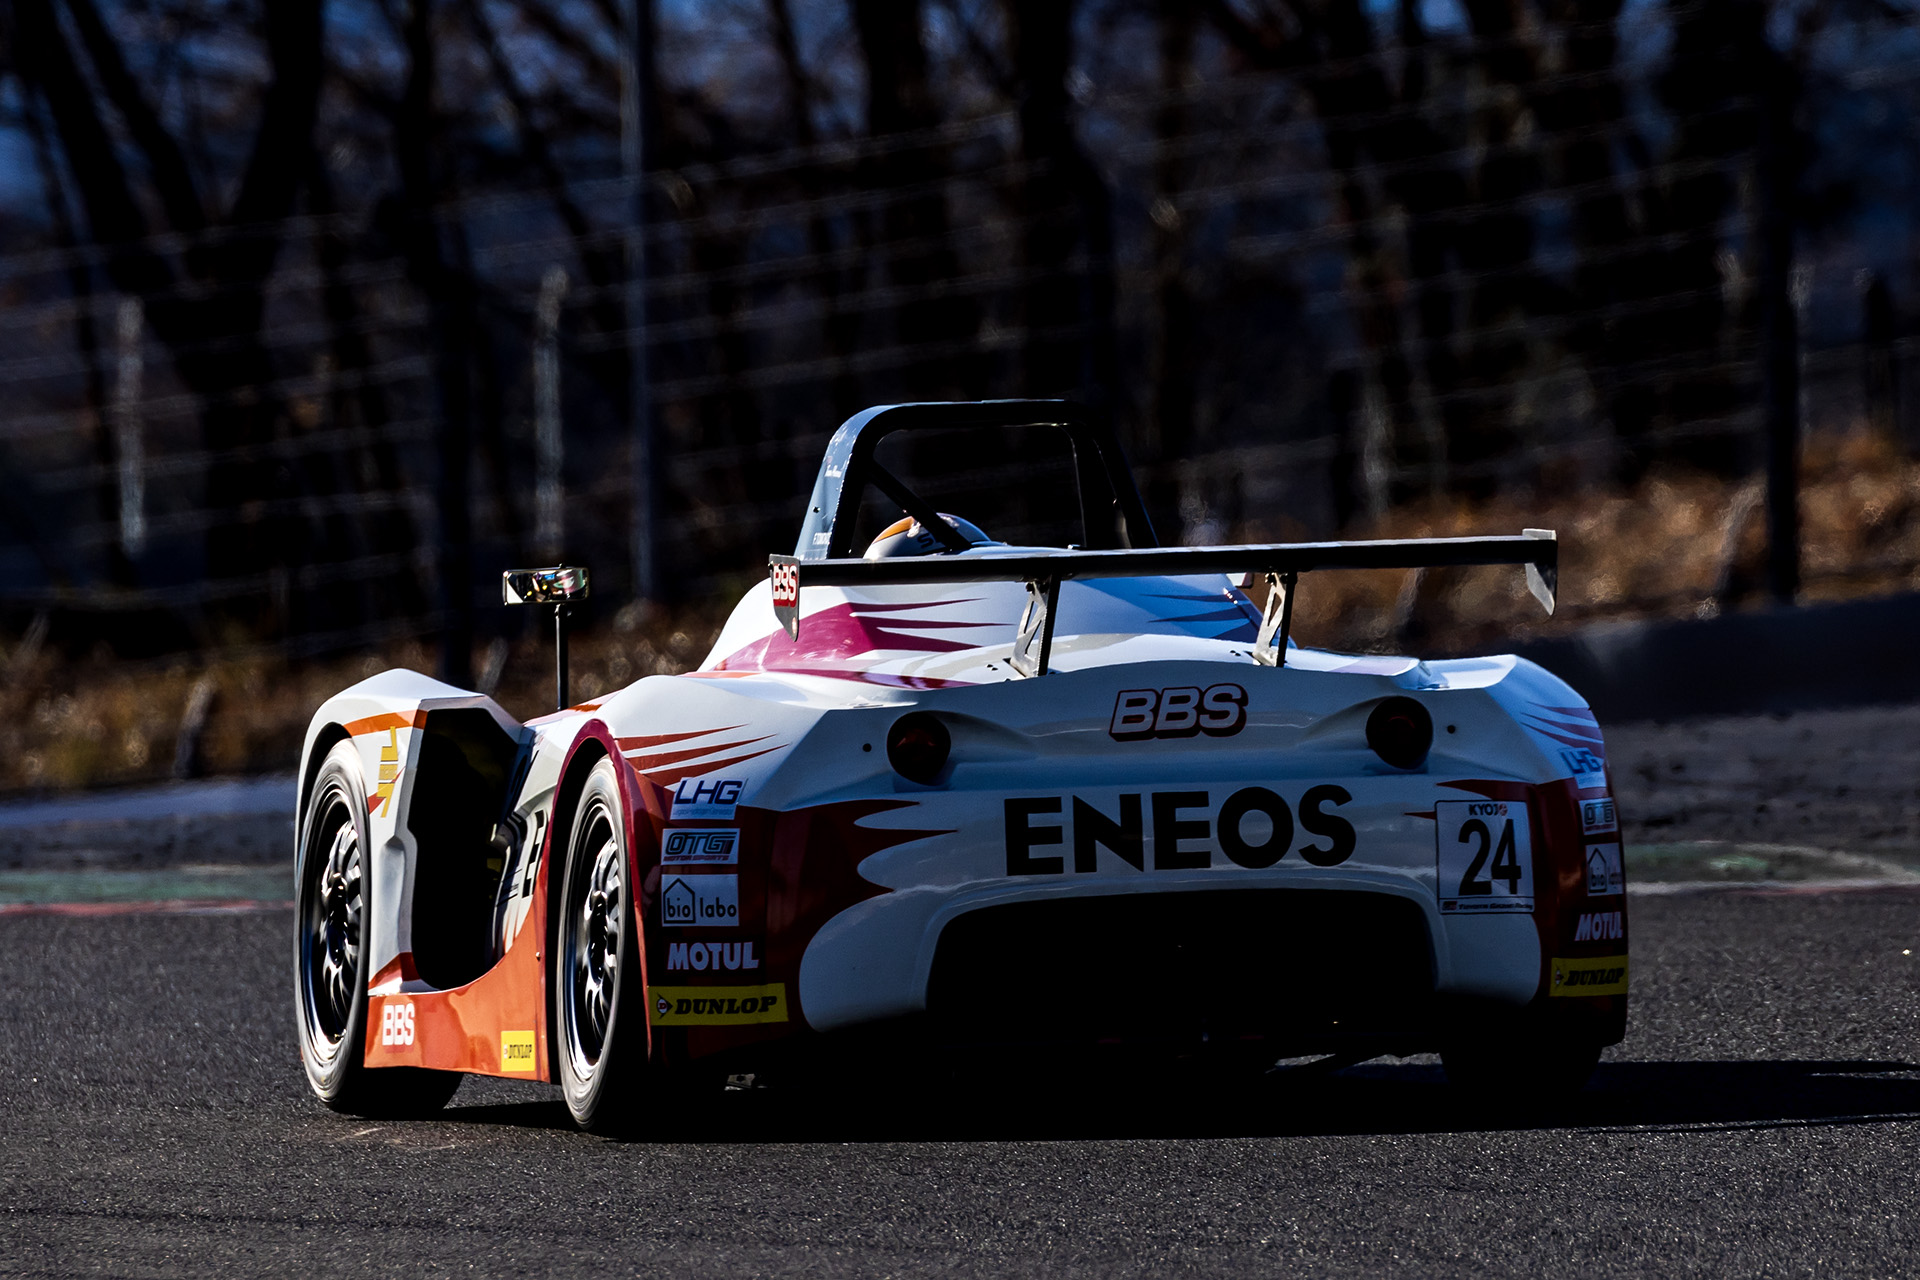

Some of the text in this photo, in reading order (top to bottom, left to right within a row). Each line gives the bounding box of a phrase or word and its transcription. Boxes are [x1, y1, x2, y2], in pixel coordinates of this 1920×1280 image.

[773, 565, 798, 605] BBS
[1109, 683, 1248, 742] BBS
[1560, 750, 1602, 774] LHG
[674, 780, 743, 804] LHG
[665, 831, 738, 855] OTG
[1003, 784, 1356, 876] ENEOS
[1458, 818, 1522, 896] 24
[667, 896, 737, 917] bio labo
[1573, 910, 1624, 942] MOTUL
[666, 941, 760, 971] MOTUL
[1564, 967, 1624, 986] DUNLOP
[675, 995, 777, 1015] DUNLOP
[382, 1003, 415, 1048] BBS
